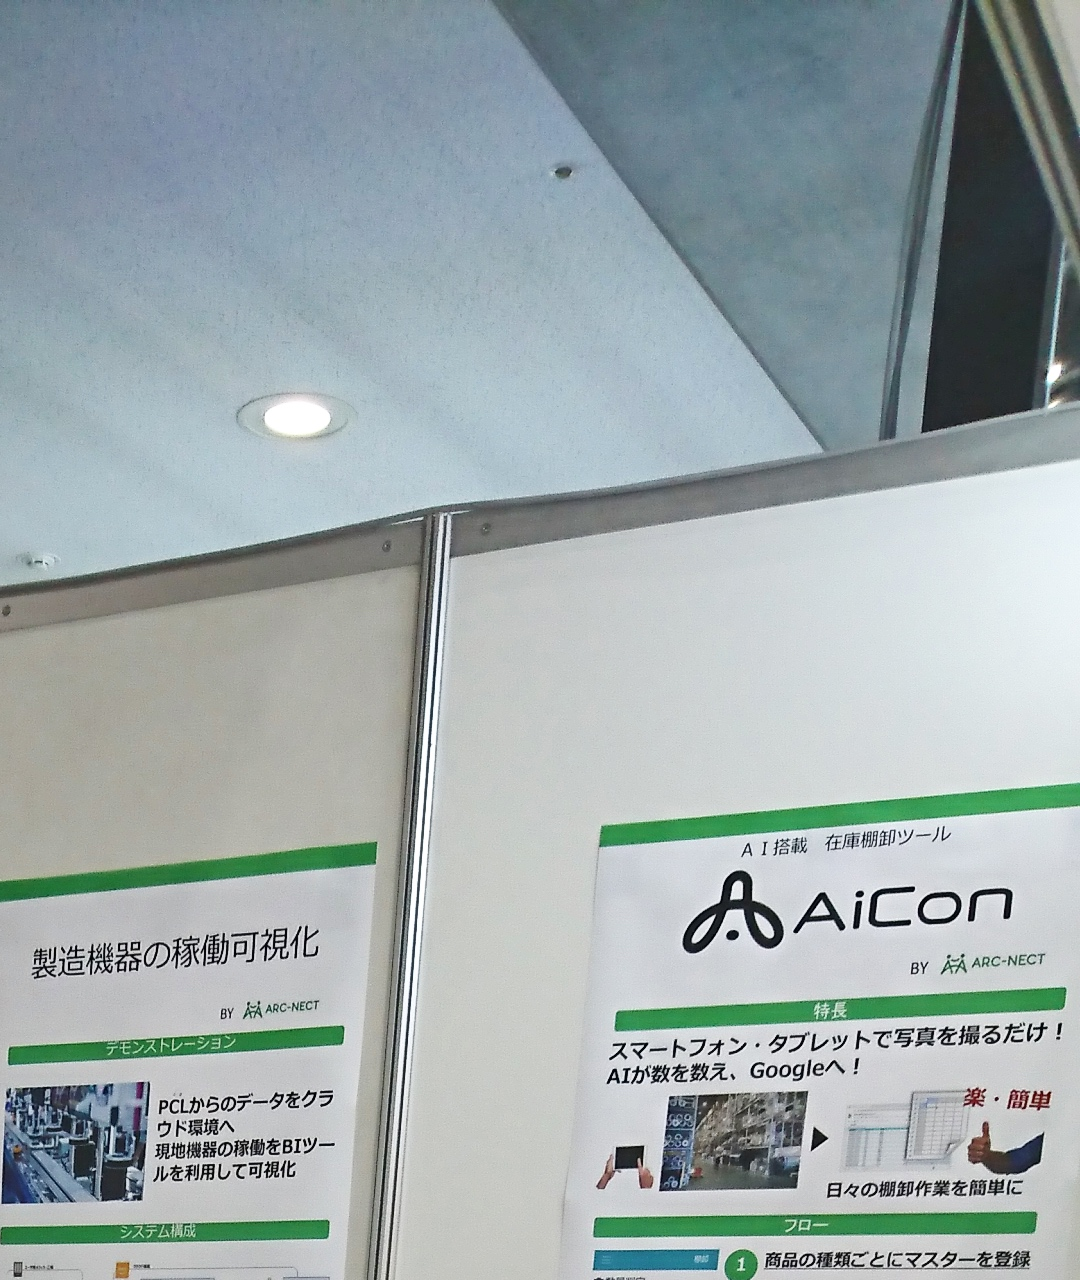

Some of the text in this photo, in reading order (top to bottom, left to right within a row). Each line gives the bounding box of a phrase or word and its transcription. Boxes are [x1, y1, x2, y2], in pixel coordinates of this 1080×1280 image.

[825, 826, 951, 851] 在庫棚卸ツール
[793, 886, 1014, 934] AiCon
[31, 925, 320, 979] 製造機器の稼働可視化
[910, 953, 1046, 975] BY ARC-NECT
[220, 1000, 319, 1020] BY ARC-NECT
[813, 1002, 847, 1020] 特長
[105, 1035, 236, 1056] デモンストレーション
[608, 1022, 1064, 1061] スマートフォン・タブレットで写真を撮るだけ！
[606, 1057, 860, 1085] AIが数を数え、Googleへ！
[158, 1089, 334, 1115] PCLからのデータをクラ
[963, 1087, 1052, 1111] 楽・簡単
[157, 1118, 235, 1138] ウド環境へ
[154, 1138, 336, 1161] 現地機器の稼働をBIツー
[153, 1160, 296, 1182] ルを利用して可視化
[826, 1178, 1023, 1199] 日々の棚卸作業を簡単に
[120, 1223, 196, 1239] システム構成
[784, 1219, 829, 1232] フロー
[737, 1257, 746, 1272] 1
[765, 1250, 1031, 1268] 商品の種類ごとにマスターを登録
